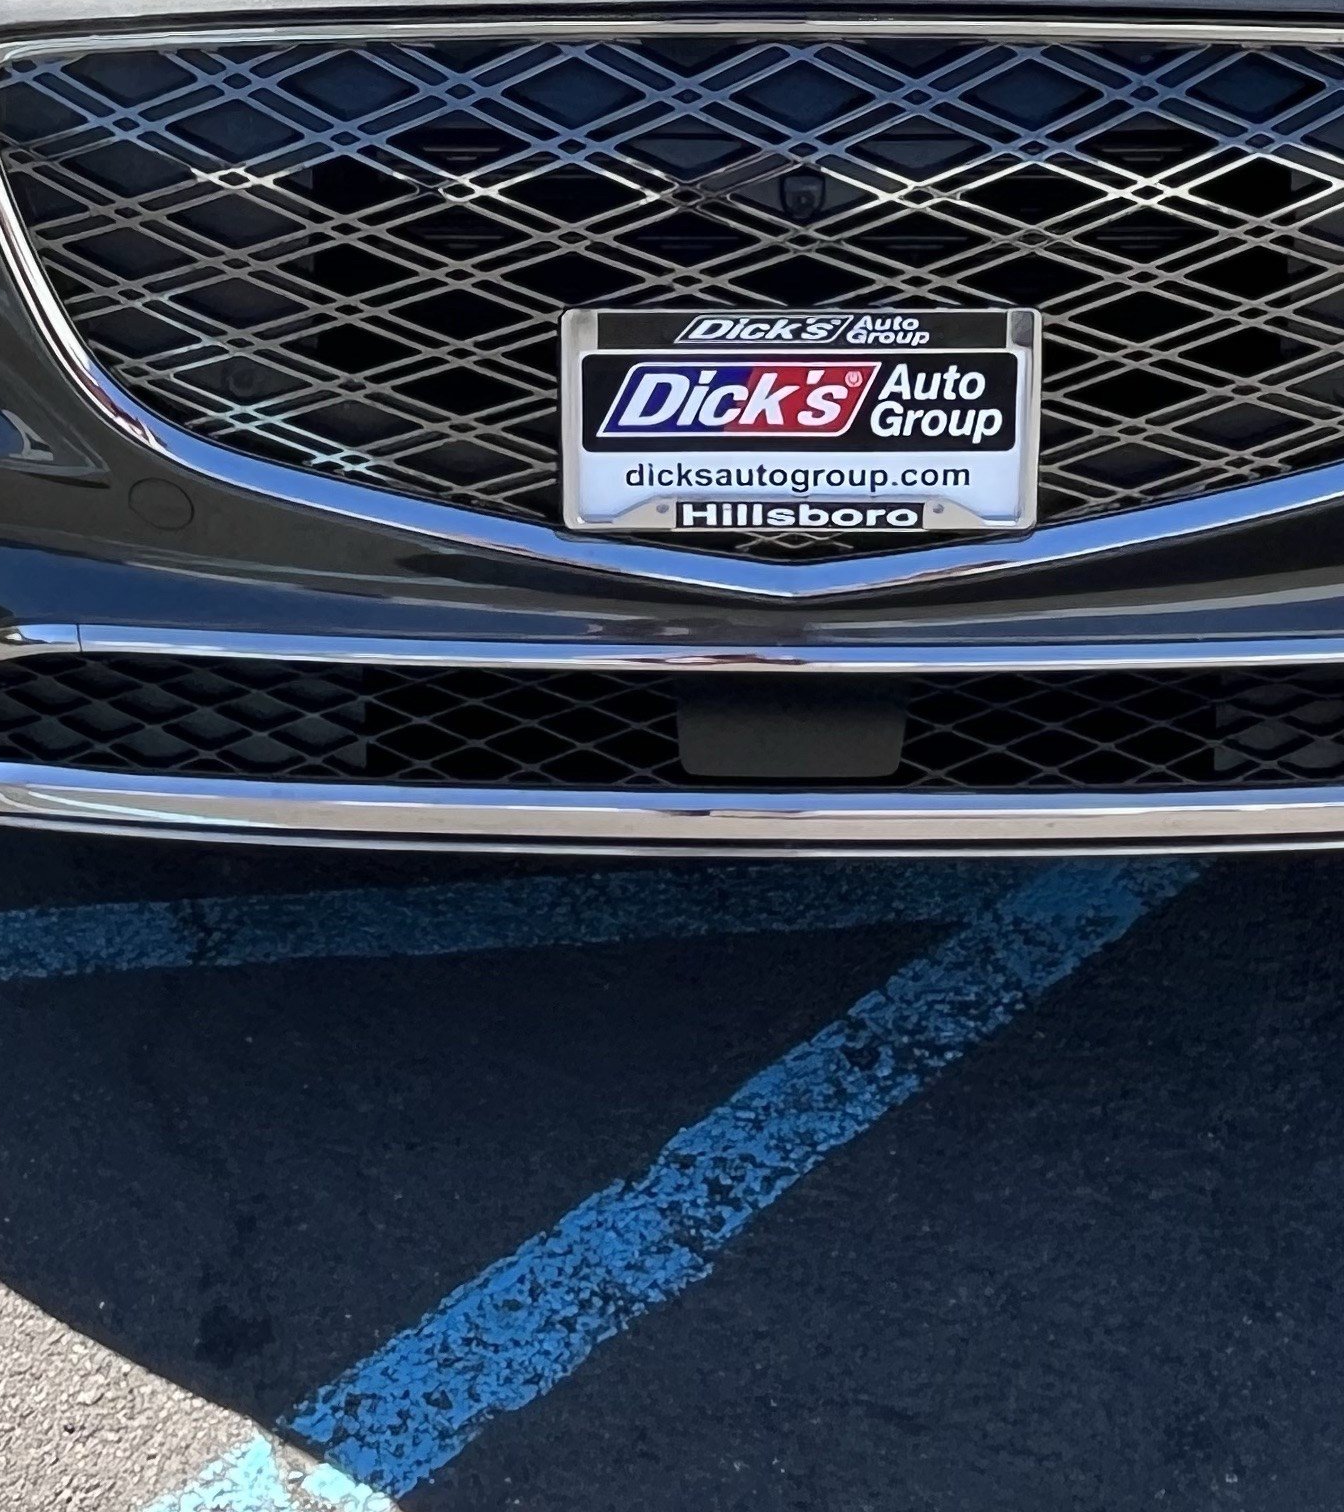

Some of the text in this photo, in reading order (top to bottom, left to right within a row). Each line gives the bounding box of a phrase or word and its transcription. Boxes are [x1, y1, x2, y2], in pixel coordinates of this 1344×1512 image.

[688, 317, 835, 341] Dick's
[853, 314, 920, 332] Auto
[846, 329, 930, 347] Group
[877, 363, 987, 402] Auto
[617, 367, 850, 428] Dick's
[870, 400, 1004, 445] Group
[625, 462, 971, 494] dicksautogroup.com
[682, 501, 919, 528] Hillsboro
